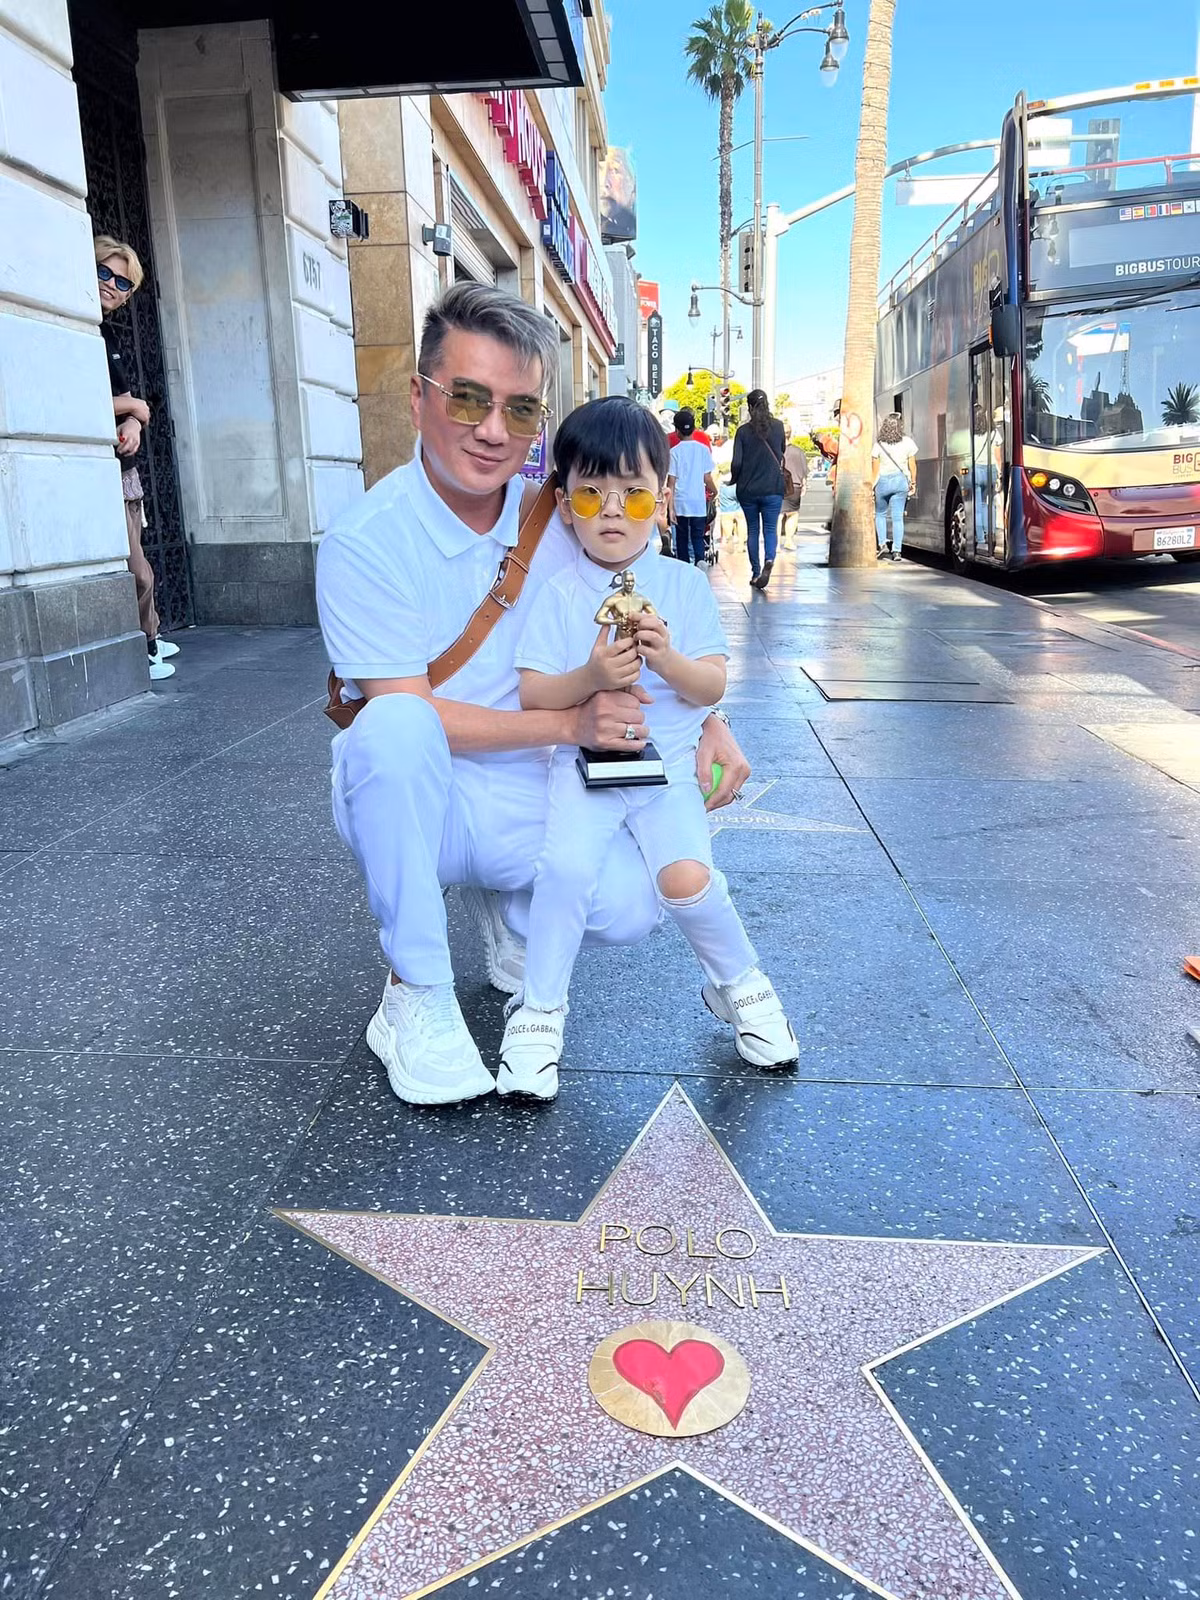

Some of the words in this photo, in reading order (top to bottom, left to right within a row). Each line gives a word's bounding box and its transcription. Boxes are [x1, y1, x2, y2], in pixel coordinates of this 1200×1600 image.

[651, 328, 659, 359] TACO
[1172, 464, 1193, 474] BUS
[1173, 453, 1193, 464] BIG
[600, 1224, 758, 1259] POLO
[576, 1270, 791, 1310] HUYNH
